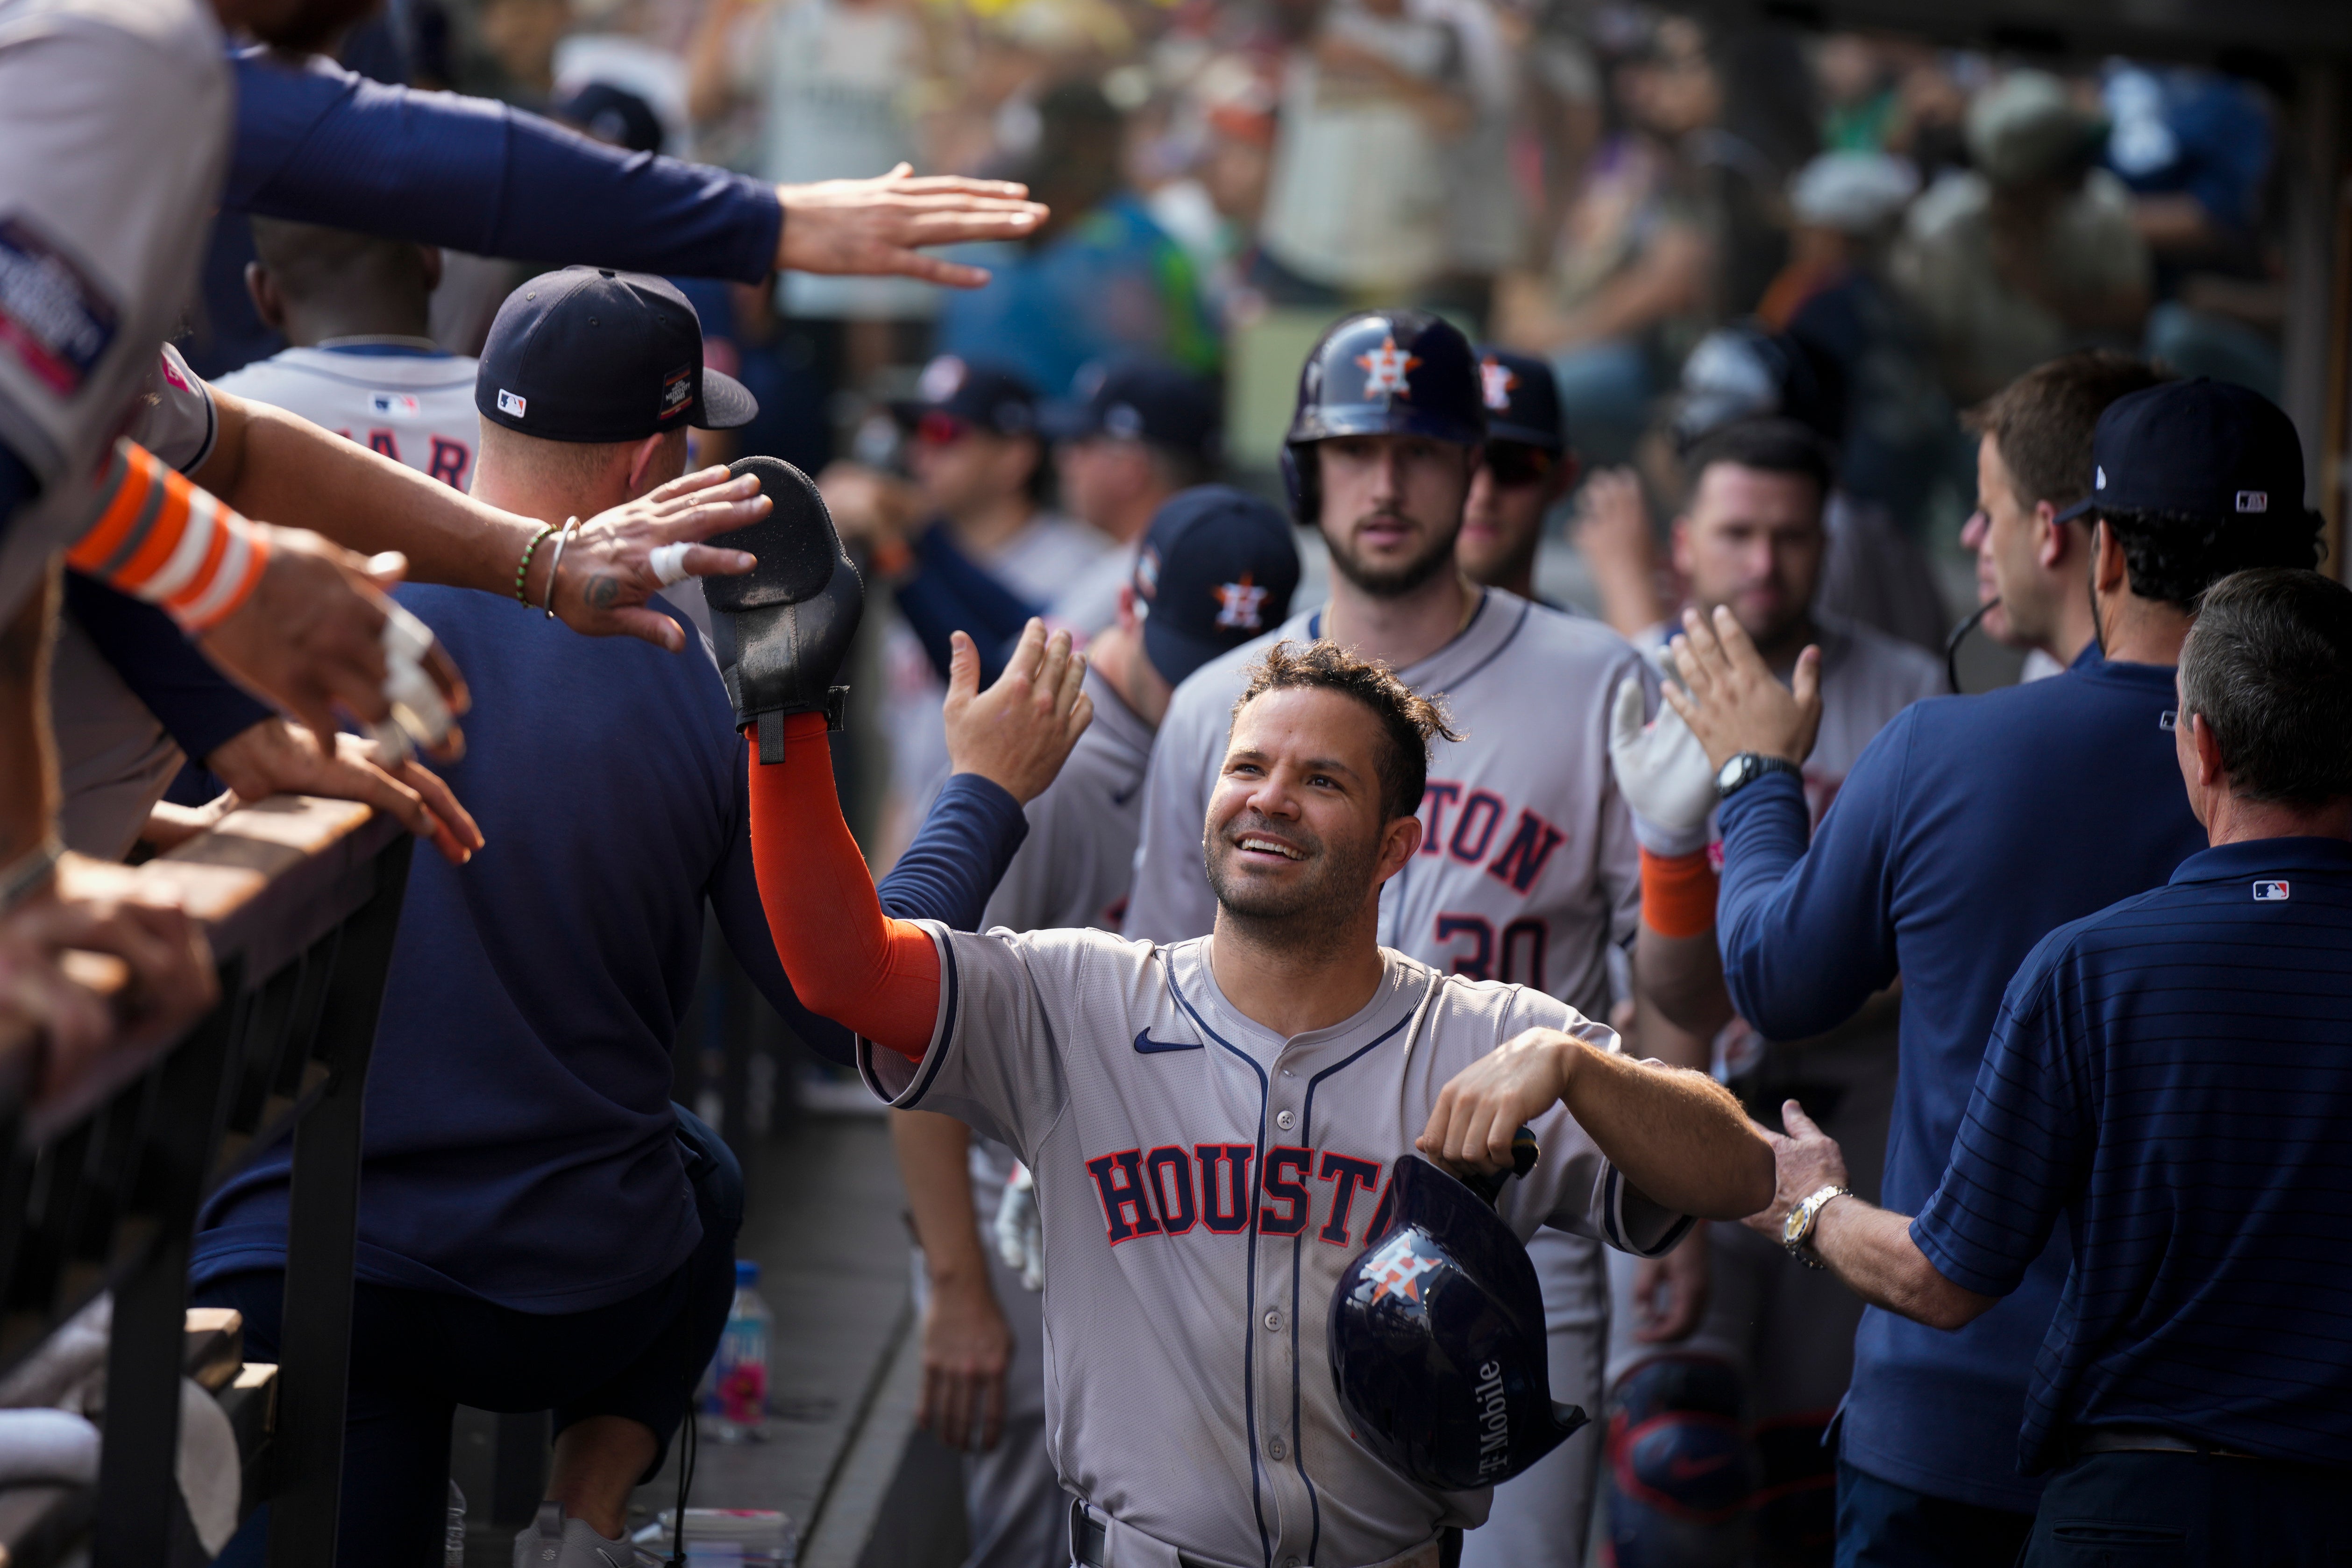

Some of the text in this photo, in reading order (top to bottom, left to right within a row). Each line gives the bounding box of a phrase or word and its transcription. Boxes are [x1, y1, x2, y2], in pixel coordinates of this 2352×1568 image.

[681, 382, 691, 392] CITY
[1421, 778, 1568, 896] TON
[1434, 911, 1550, 992] 30
[1086, 1143, 1392, 1248] HOUST
[1370, 1245, 1438, 1299] H
[1475, 1360, 1508, 1475] T-Mobile
